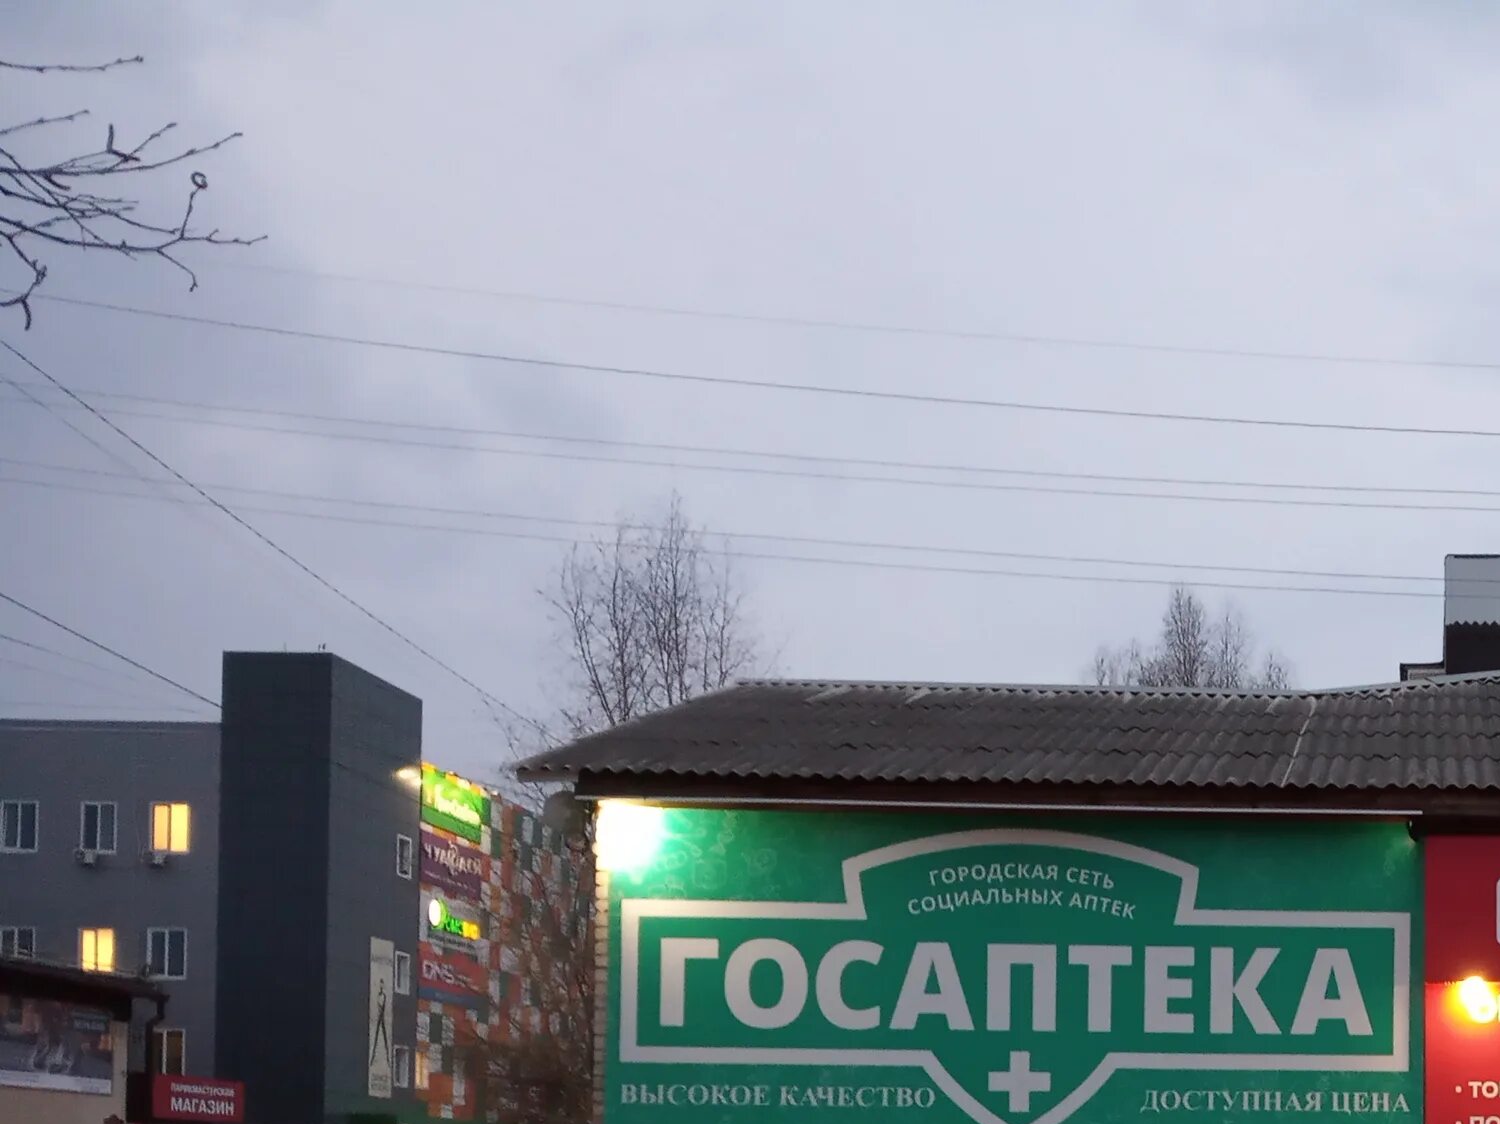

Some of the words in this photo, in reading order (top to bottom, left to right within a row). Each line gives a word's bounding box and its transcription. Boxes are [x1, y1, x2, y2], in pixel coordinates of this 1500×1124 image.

[928, 862, 1058, 888] ГОРОДСКАЯ
[1065, 867, 1116, 891] СЕТЬ
[907, 887, 1063, 916] СОЦИАЛЬНЫХ
[1069, 892, 1138, 920] АПТЕК
[658, 936, 1375, 1037] ГОСАПТЕКА
[170, 1096, 234, 1116] МАГАЗИН
[619, 1083, 772, 1108] ВЫСОКОЕ
[780, 1085, 936, 1110] КАЧЕСТВО
[1139, 1088, 1323, 1116] ДОСТУПНАЯ
[1329, 1091, 1411, 1117] ЦЕНА
